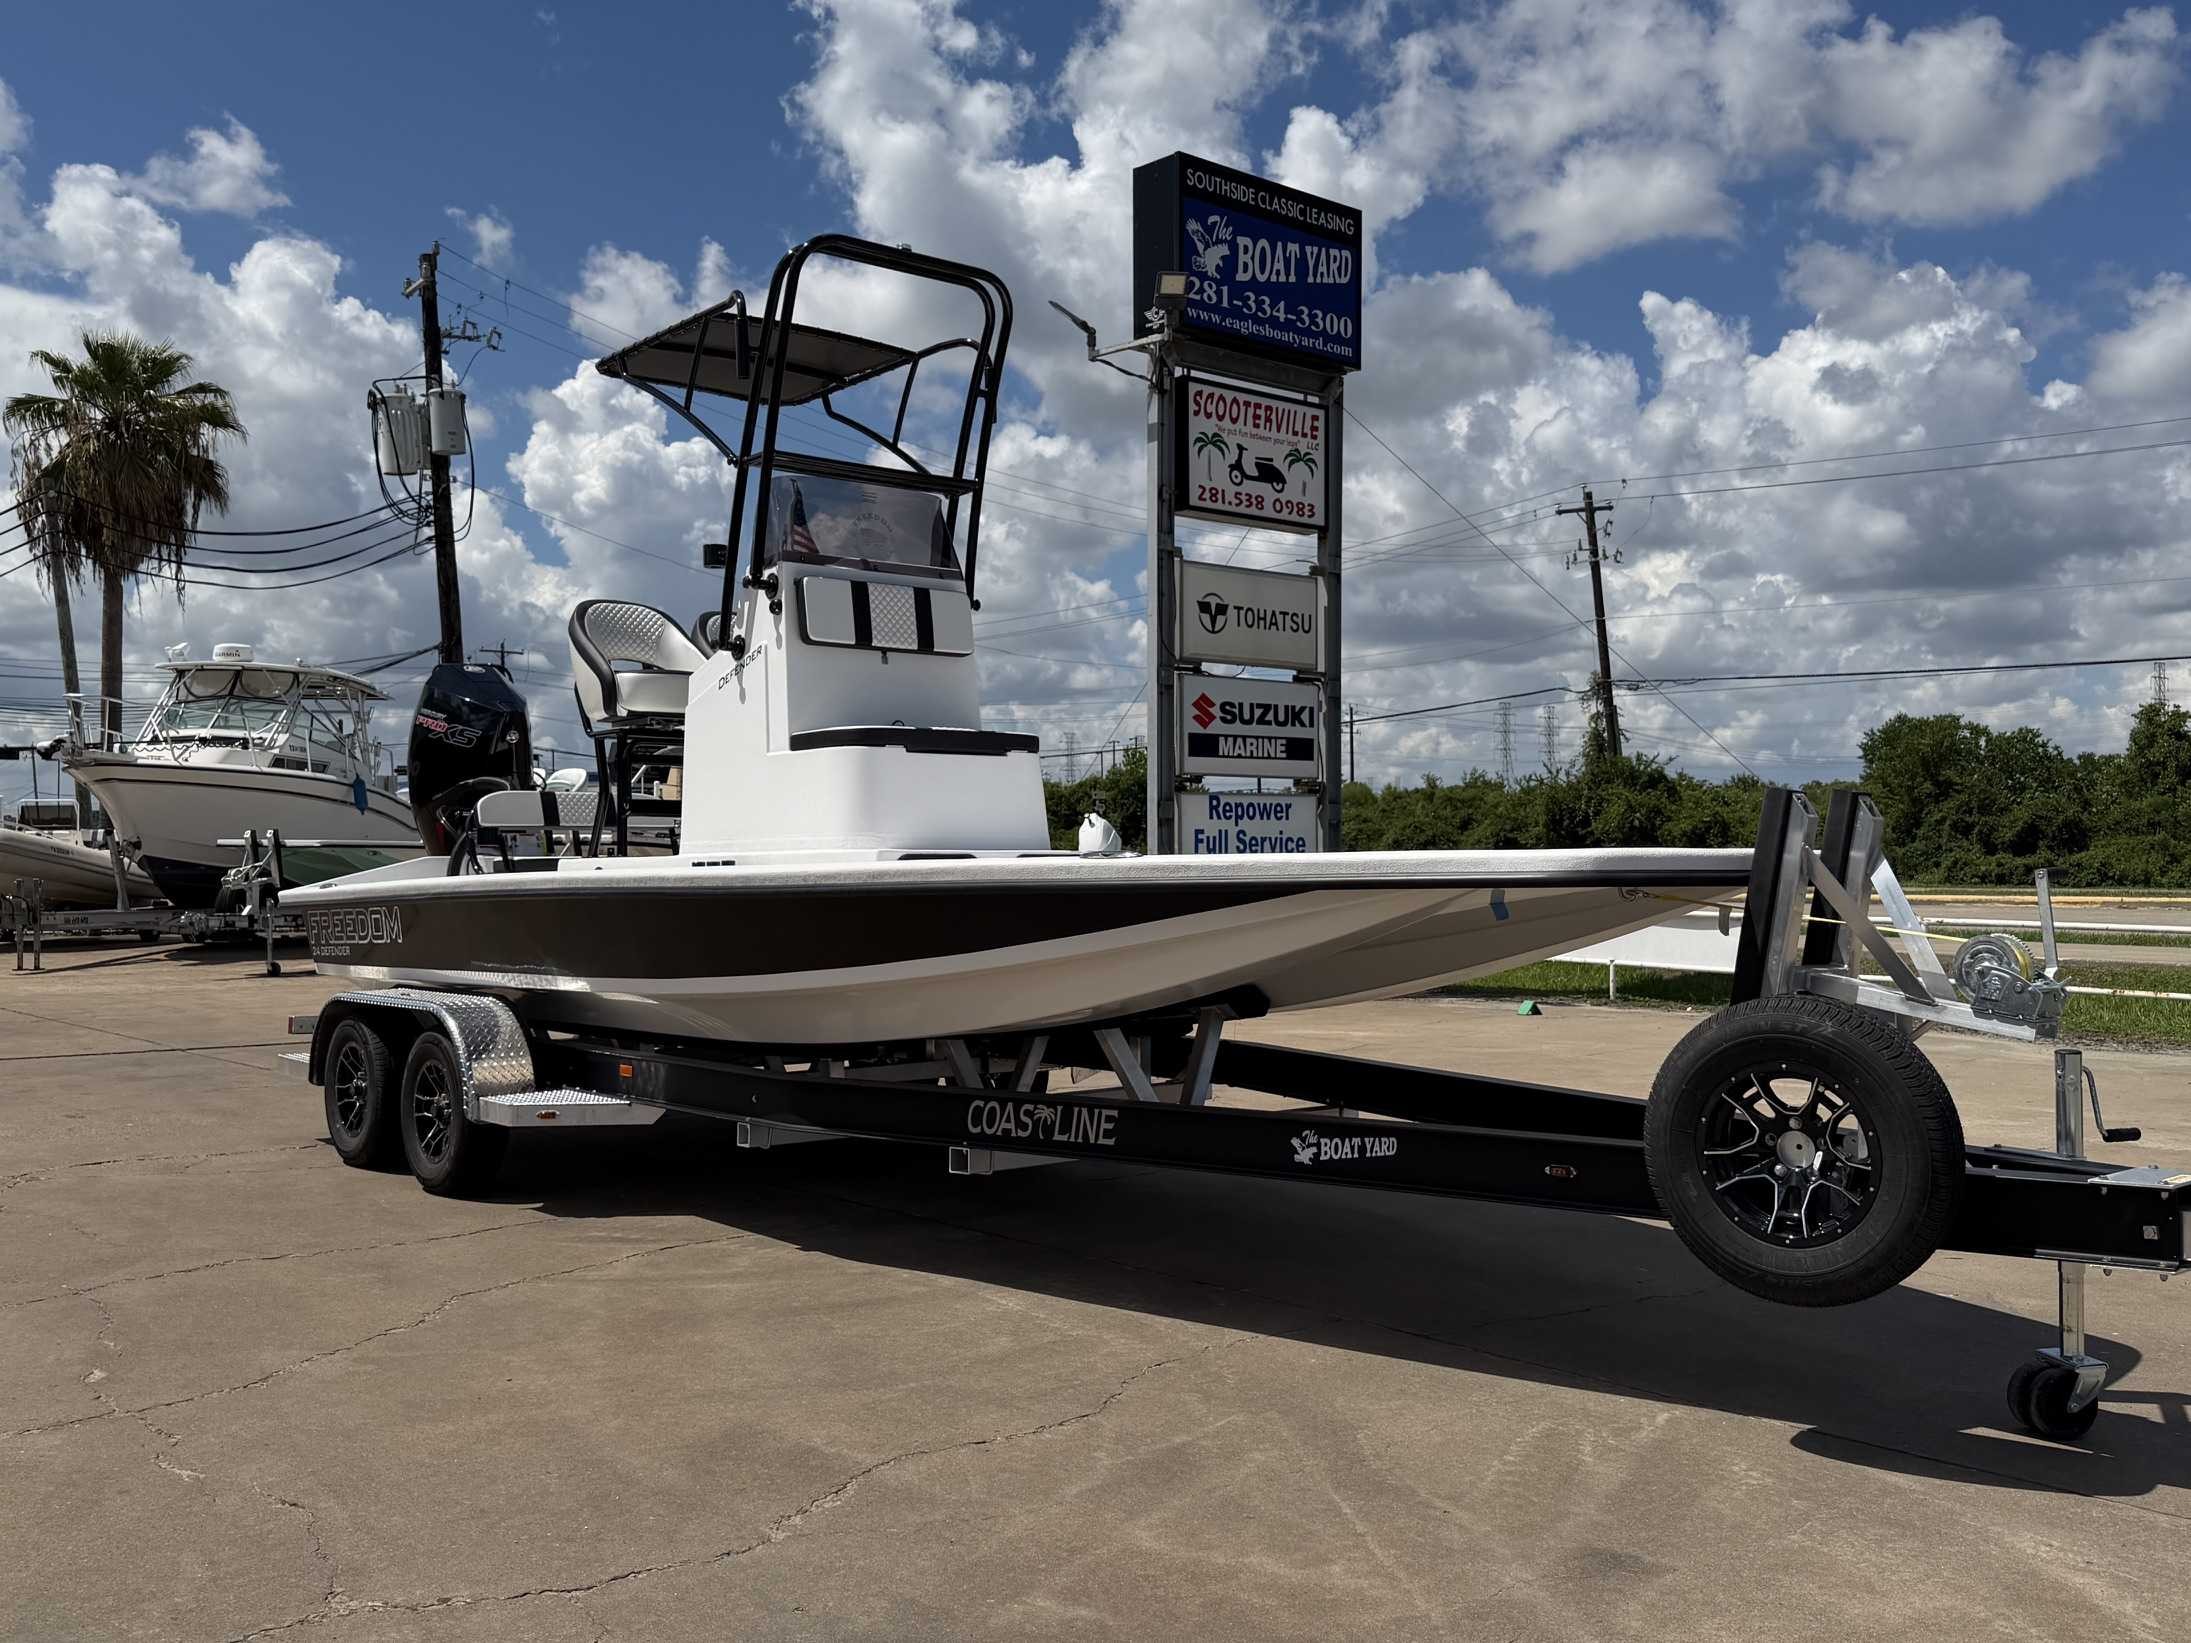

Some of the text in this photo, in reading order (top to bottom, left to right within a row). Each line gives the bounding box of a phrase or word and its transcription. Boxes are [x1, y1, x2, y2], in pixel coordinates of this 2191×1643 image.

[1186, 168, 1355, 235] SOUTHSIDE CLASSIC LEASING
[1207, 214, 1233, 243] The
[1235, 236, 1352, 284] BOAT YARD
[1187, 276, 1353, 339] 281-334-3300
[1186, 306, 1353, 357] www.eaglesboatyard.com
[1193, 389, 1320, 441] SCOOTERVILLE
[1307, 442, 1320, 451] LLC
[1197, 485, 1316, 519] 281.538 0983
[1233, 605, 1312, 634] TOHATSU
[718, 644, 763, 690] DEFENDER
[1219, 701, 1315, 729] SUZUKI
[428, 723, 483, 748] XS
[1218, 736, 1287, 758] MARINE
[1208, 795, 1292, 827] Repower
[1193, 829, 1306, 853] Full Service
[307, 905, 403, 945] FREEDOM
[320, 945, 351, 956] DEFENDER
[1302, 1129, 1318, 1146] The
[1319, 1137, 1398, 1161] BOAT YARD
